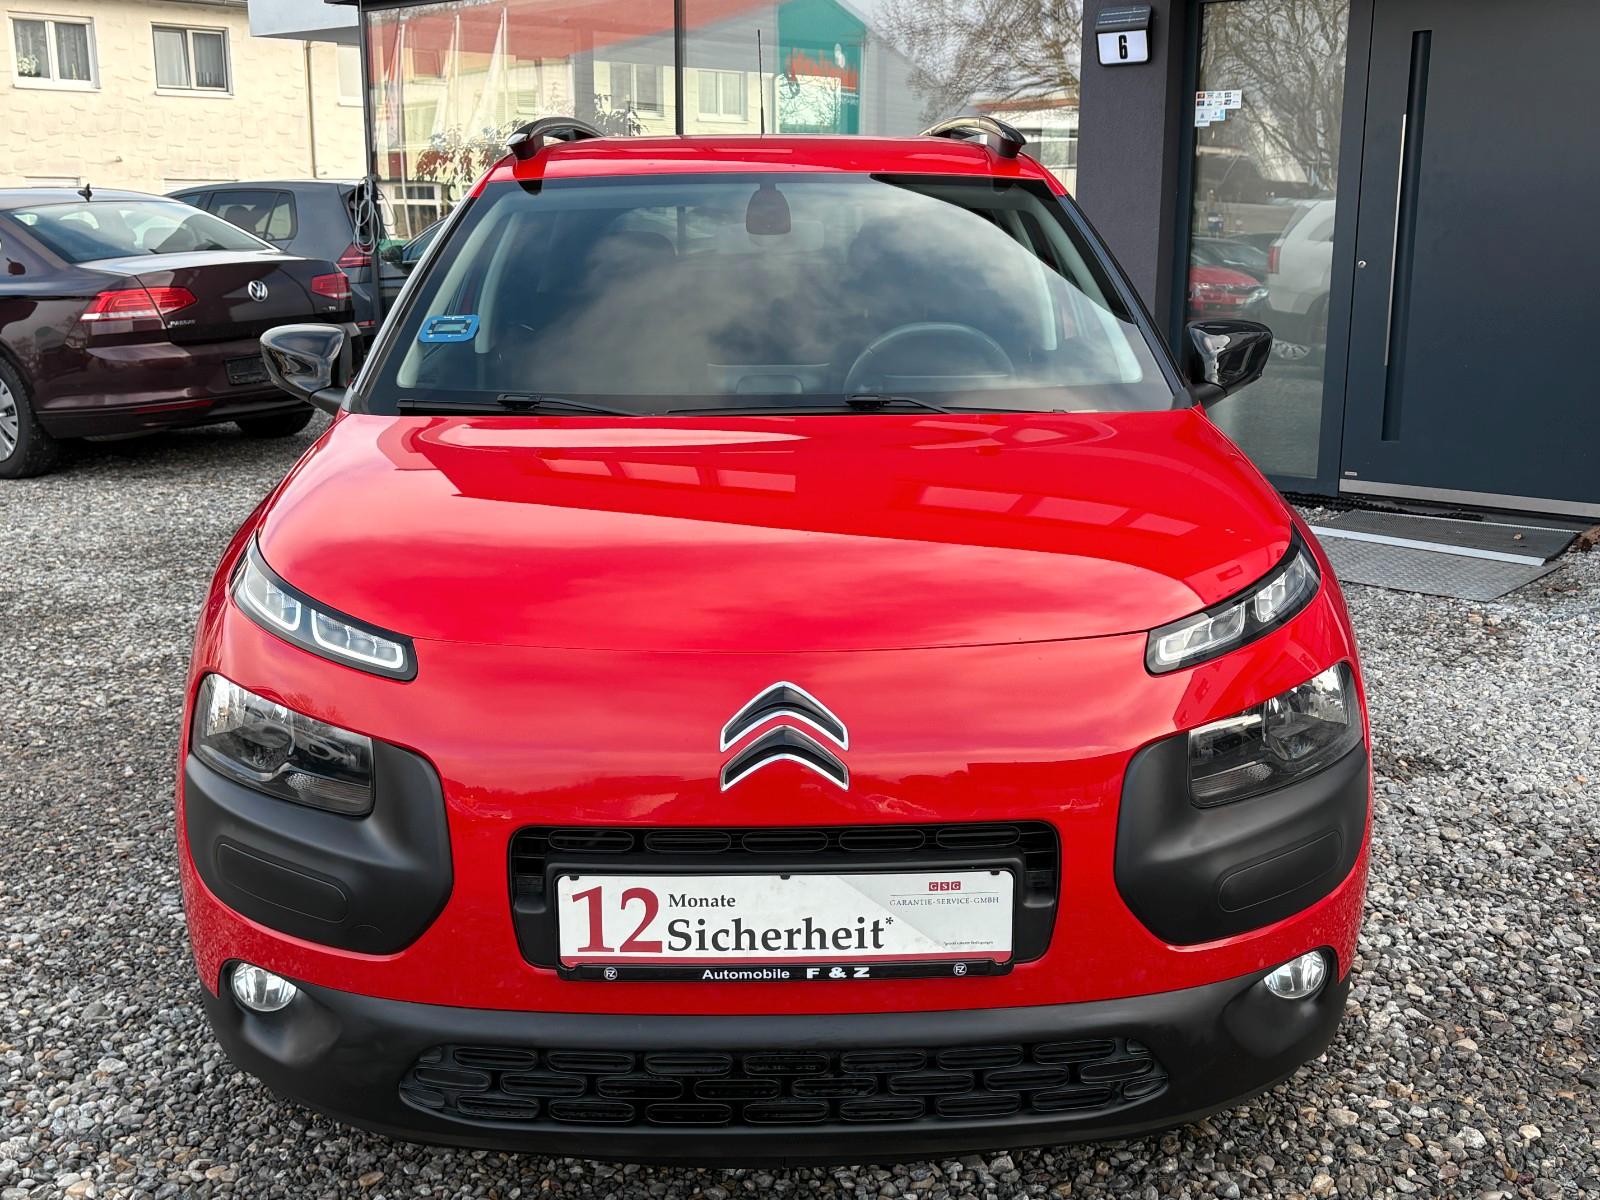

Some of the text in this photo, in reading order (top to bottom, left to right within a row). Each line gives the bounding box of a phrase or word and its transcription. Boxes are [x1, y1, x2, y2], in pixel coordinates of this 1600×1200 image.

[1118, 34, 1128, 60] 6
[929, 881, 961, 891] GSG
[667, 893, 736, 908] Monate
[889, 896, 999, 906] GARANTIE-SERVICE-GMBH
[571, 885, 663, 953] 12
[702, 966, 871, 980] Automobile F & Z
